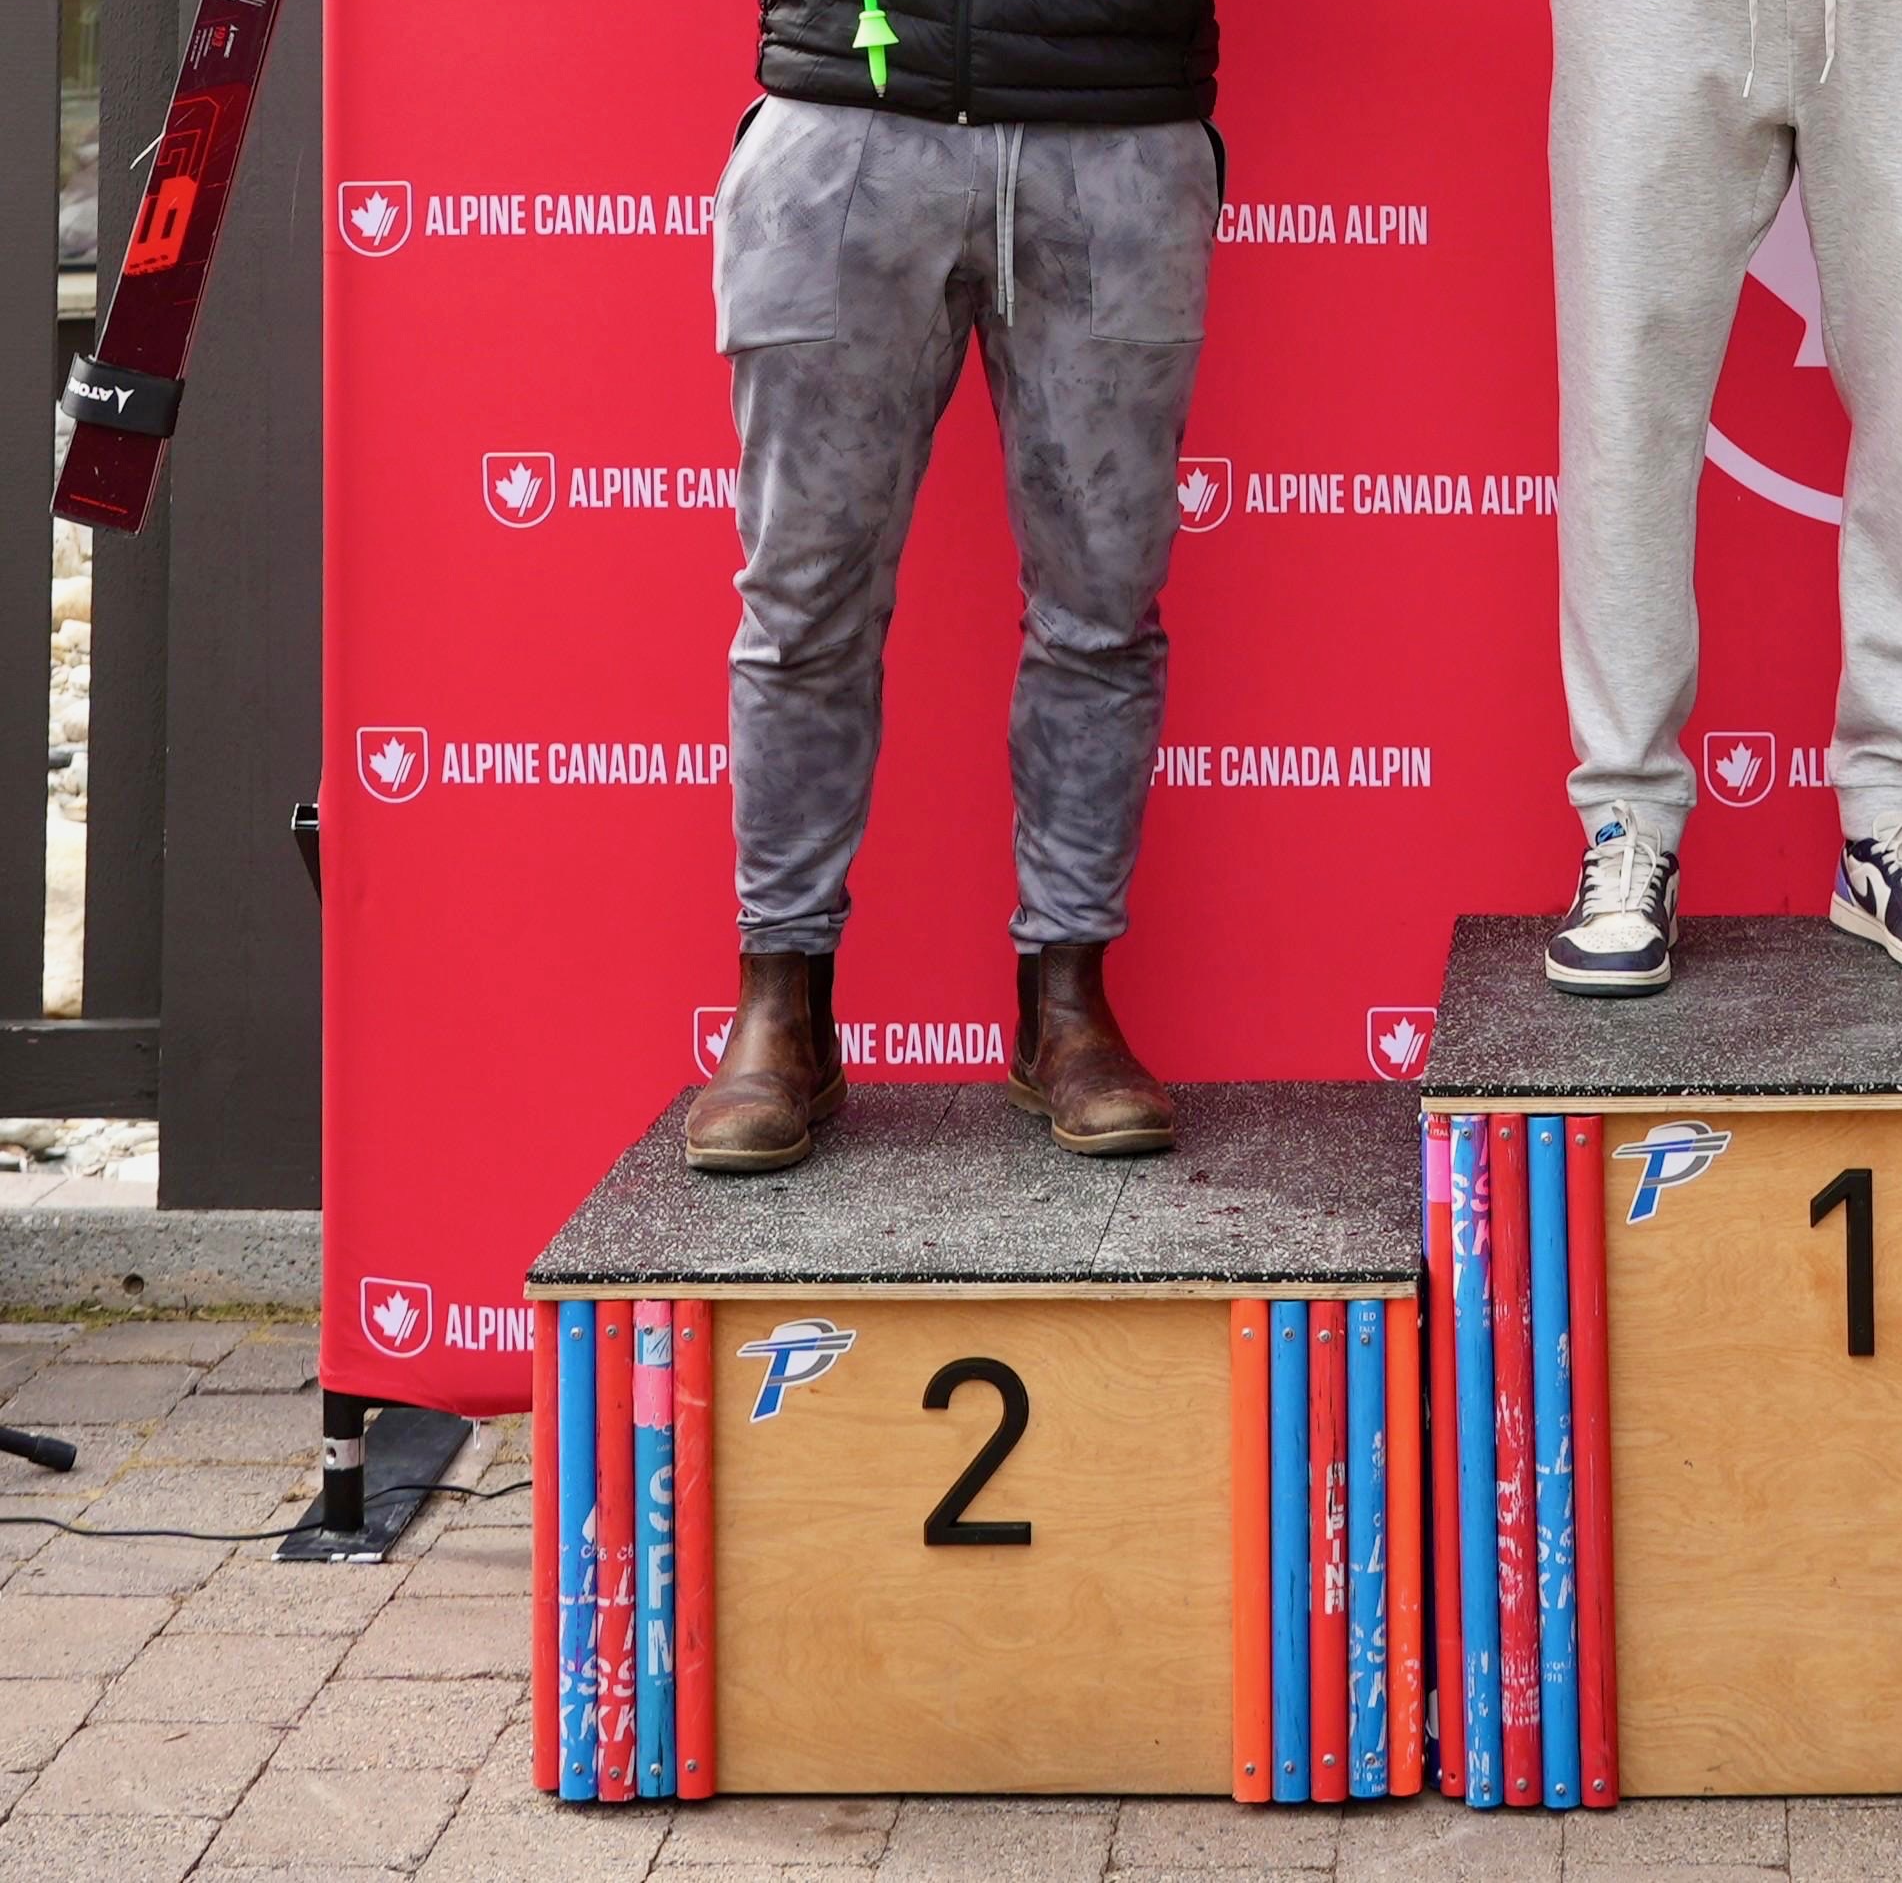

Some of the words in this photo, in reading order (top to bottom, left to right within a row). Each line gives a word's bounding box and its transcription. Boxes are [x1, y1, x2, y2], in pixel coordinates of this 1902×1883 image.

[425, 194, 526, 236] ALPINE
[534, 194, 657, 235] CANADA
[664, 195, 715, 236] ALP
[1216, 204, 1336, 243] CANADA
[1344, 205, 1427, 245] ALPIN
[67, 376, 114, 402] ATOM
[569, 467, 669, 508] ALPINE
[676, 467, 735, 508] CAN
[1245, 473, 1345, 514] ALPINE
[1353, 474, 1473, 515] CANADA
[1481, 475, 1557, 515] ALPIN
[441, 743, 540, 784] ALPINE
[548, 743, 668, 784] CANADA
[675, 744, 729, 784] ALP
[1151, 746, 1212, 786] PINE
[1221, 746, 1340, 787] CANADA
[1348, 747, 1431, 787] ALPIN
[885, 1023, 1004, 1065] CANADA
[1810, 1168, 1875, 1357] 1
[922, 1356, 1033, 1547] 2
